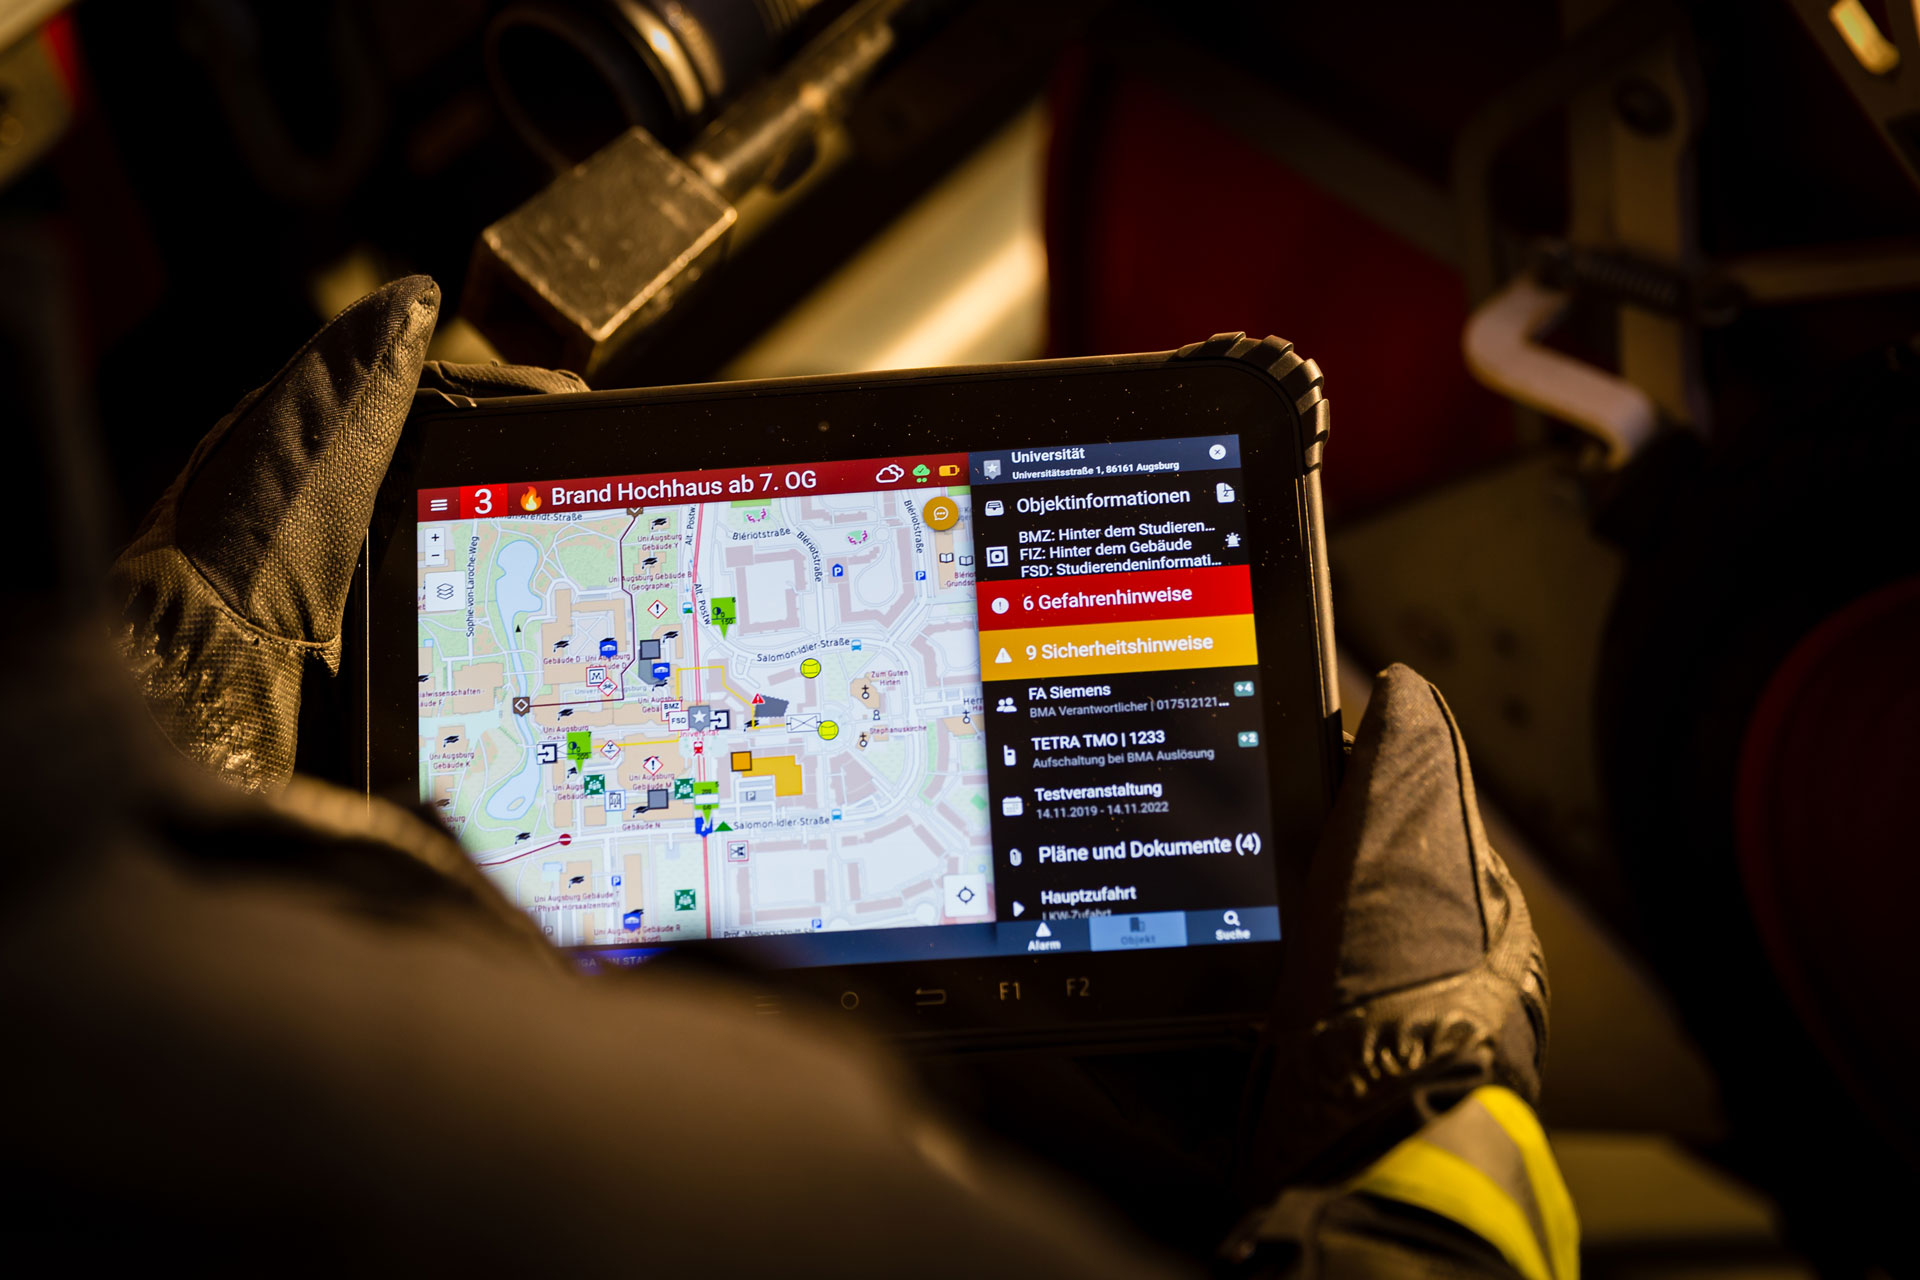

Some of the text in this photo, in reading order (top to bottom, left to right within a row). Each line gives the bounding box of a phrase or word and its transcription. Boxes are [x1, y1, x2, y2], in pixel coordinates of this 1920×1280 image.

[1011, 447, 1085, 464] Universität
[1012, 461, 1180, 480] Universitätsstraße 1, 86161 Augsburg
[551, 470, 817, 506] Brand Hochhaus ab 7. OG
[474, 488, 493, 515] 3
[1016, 490, 1191, 516] Objektinformationen
[732, 527, 791, 541] Blériotstraße
[903, 499, 925, 554] Blériotstraße
[1018, 529, 1056, 544] BMZ:
[1058, 527, 1102, 542] Hinter
[1104, 524, 1136, 539] dem
[796, 531, 823, 583] Blériotstraße
[1019, 538, 1193, 561] FIZ: Hinter dem Gebäude
[1020, 564, 1054, 579] FSD:
[466, 536, 480, 637] Sophie-von-Laroche-Weg
[1022, 587, 1193, 611] 6 Gefahrenhinweise
[1025, 636, 1214, 660] 9 Sicherheitshinweise
[1028, 684, 1111, 700] FA Siemens
[1029, 707, 1056, 719] BMA
[1058, 701, 1148, 717] Verantwortlicher
[1031, 735, 1080, 751] TETRA
[1083, 733, 1118, 748] TMO
[1129, 729, 1166, 745] 1233
[1032, 748, 1215, 769] Aufschaltung bei BMA Auslösung
[1034, 782, 1163, 802] Testveranstaltung
[1036, 806, 1099, 820] 14.11.2019
[1106, 801, 1169, 816] 14.11.2022
[1038, 832, 1262, 864] Pläne und Dokumente (4)
[1041, 885, 1137, 906] Hauptzufahrt
[1120, 935, 1156, 948] Objekt
[1215, 928, 1251, 941] Suche
[1027, 940, 1061, 951] Alarm
[999, 981, 1020, 1001] F1
[1066, 978, 1090, 997] F2
